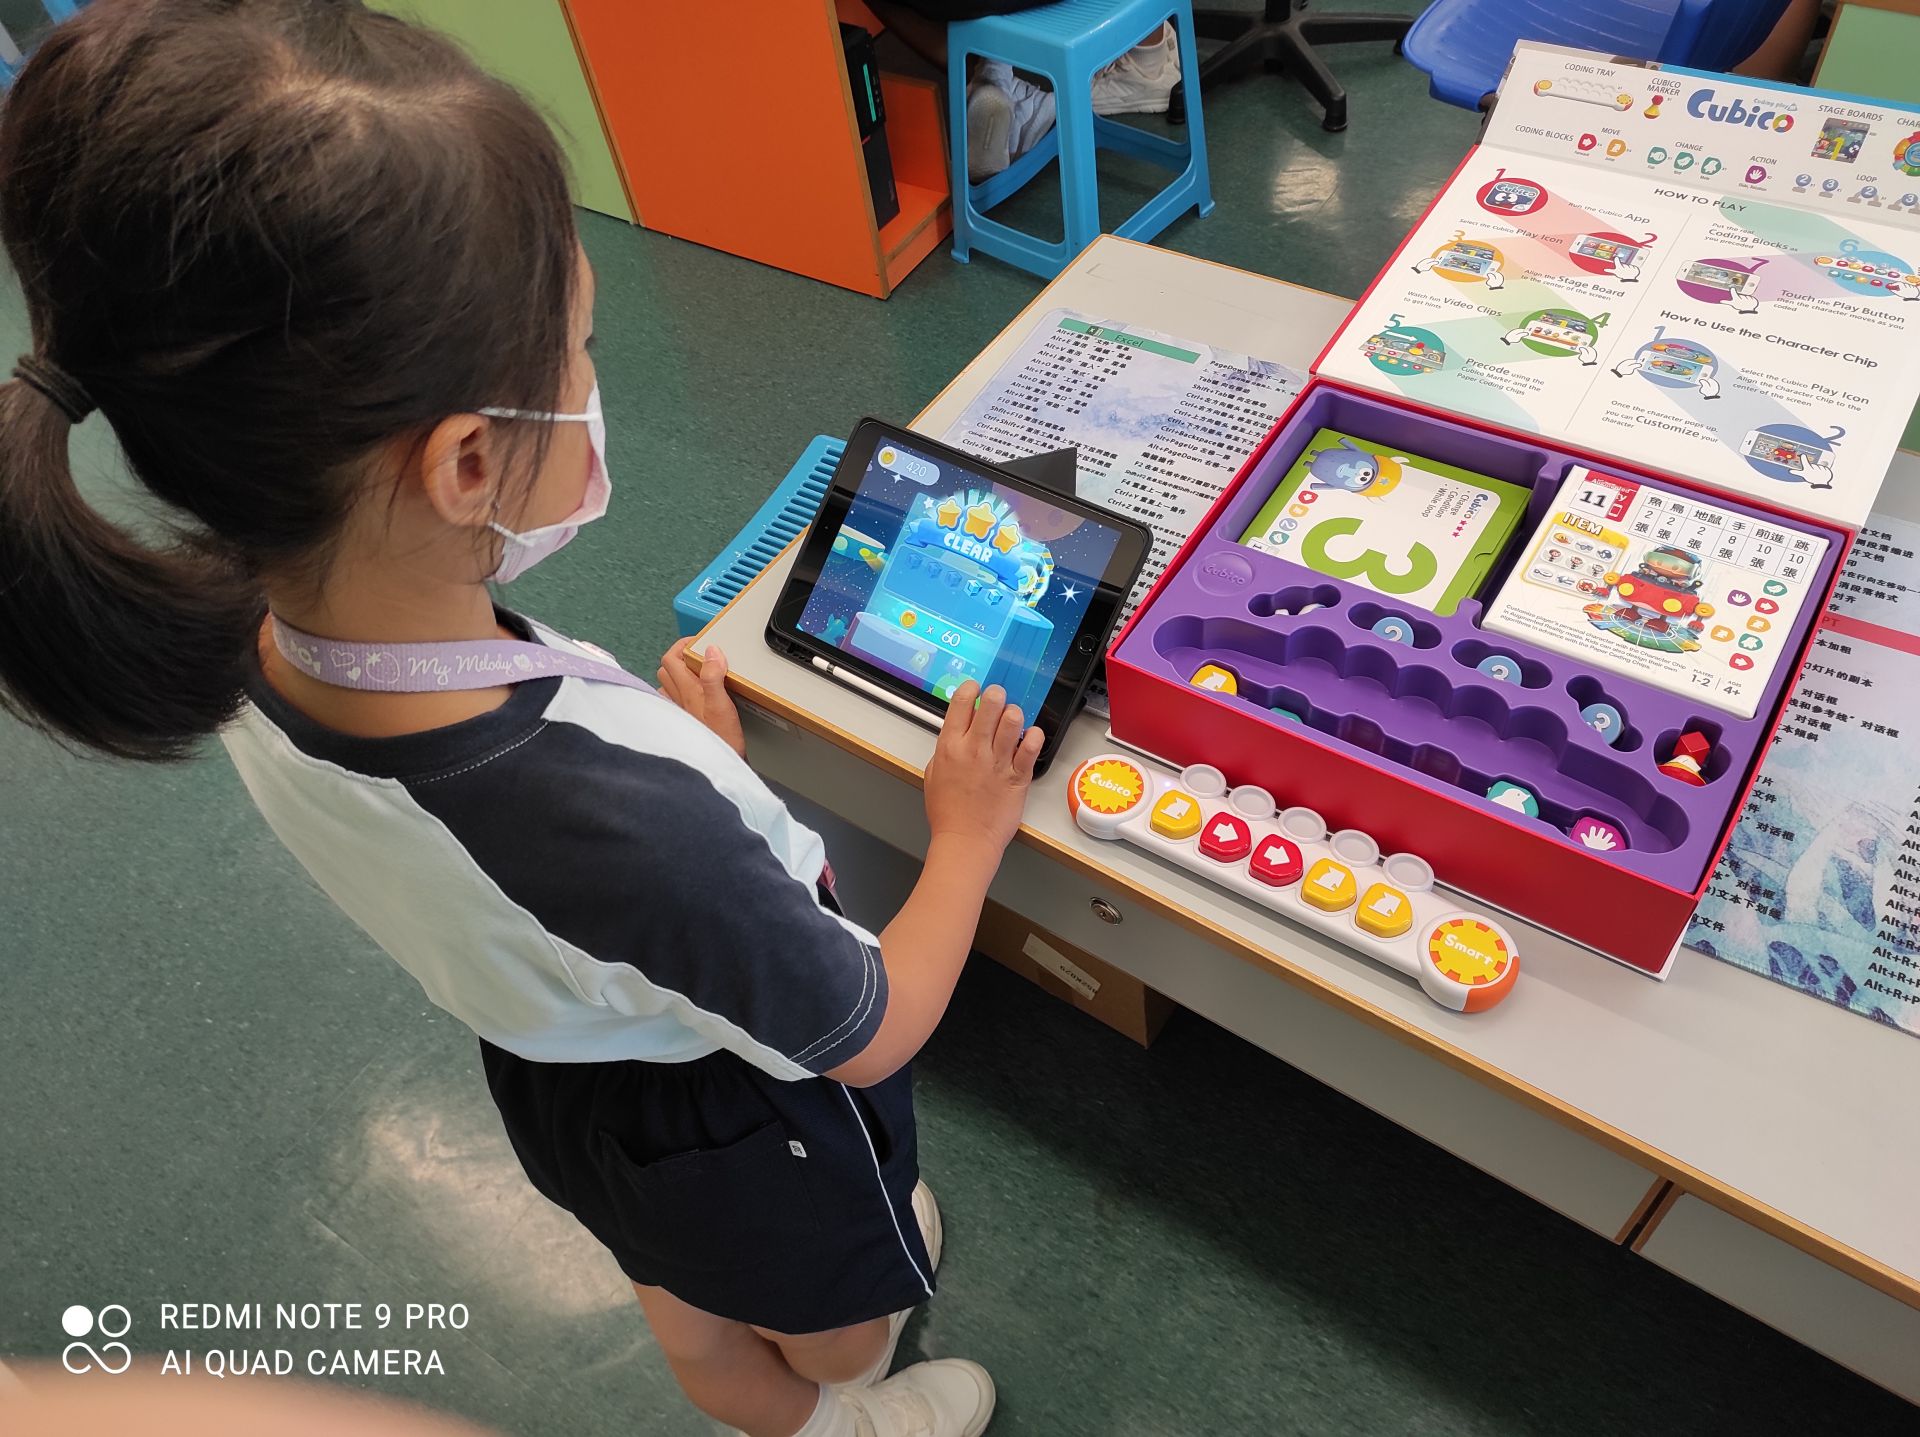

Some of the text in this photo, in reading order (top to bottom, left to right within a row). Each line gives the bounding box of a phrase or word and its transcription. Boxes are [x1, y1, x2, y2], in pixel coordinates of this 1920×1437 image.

[1565, 63, 1616, 77] CODING TRAY
[1647, 85, 1680, 96] MARKER
[1652, 78, 1681, 88] CUBICO
[1687, 89, 1794, 133] Cubico
[1818, 105, 1883, 121] STAGE BOARDS
[1515, 125, 1573, 141] CODING BLOCKS
[1601, 128, 1621, 136] MOVE
[1675, 142, 1703, 151] CHANGE
[1750, 156, 1777, 165] ACTION
[1654, 188, 1746, 211] HOW TO PLAY
[1598, 208, 1623, 217] Cubico
[1624, 213, 1650, 224] App
[1493, 225, 1514, 234] Cubico
[1515, 228, 1539, 240] Play
[1541, 233, 1563, 244] Icon
[1708, 229, 1789, 250] Coding Blocks
[1720, 239, 1754, 250] preceded
[1524, 269, 1544, 279] Align
[1559, 275, 1589, 290] Stage
[1592, 282, 1626, 298] Board
[1543, 280, 1611, 301] center screen
[1407, 290, 1428, 300] Watch
[1443, 296, 1473, 310] Video
[1477, 305, 1502, 318] Clips
[1425, 301, 1442, 310] hints
[1773, 303, 1797, 312] coded
[1776, 297, 1795, 305] then
[1812, 305, 1848, 317] character
[1850, 314, 1875, 324] moves
[1888, 323, 1904, 331] you
[1781, 290, 1905, 324] Touch the Play Button
[1384, 314, 1405, 330] 5
[1115, 335, 1143, 347] Excel
[1660, 310, 1878, 369] How to Use the Character Chip
[1210, 361, 1247, 374] PageDown
[1465, 357, 1545, 385] Precode using the
[1456, 373, 1525, 396] Paper Coding Chips
[1461, 366, 1541, 392] Cubico Marker and the
[1740, 367, 1870, 404] Select the Cubico Play Icon
[1732, 383, 1811, 407] center the screen
[1736, 374, 1861, 411] Align the Character Chip the
[1601, 416, 1634, 428] character
[1611, 400, 1630, 409] Once
[1647, 410, 1683, 422] character
[1684, 420, 1704, 429] pops
[1605, 409, 1619, 417] you
[1636, 415, 1700, 438] Customize
[1701, 434, 1718, 443] your
[1825, 425, 1845, 446] 2
[906, 462, 927, 477] 420
[1422, 488, 1447, 518] While loop
[1436, 491, 1459, 518] Condition
[1450, 495, 1470, 516] Change
[1580, 491, 1607, 508] 11
[1562, 512, 1603, 536] ITEM
[1647, 496, 1663, 508] 魚
[1671, 503, 1685, 515] 鳥
[1693, 508, 1722, 526] 地鼠
[1732, 520, 1746, 531] 手
[1794, 539, 1810, 552] 跳
[943, 532, 993, 563] CLEAR
[1644, 510, 1804, 564] 2 2 2 8 10 10
[1301, 517, 1437, 594] 3
[1635, 522, 1797, 578] 張 張 張 張 張 張
[1202, 563, 1246, 585] Cubico
[942, 631, 960, 647] 60
[408, 654, 512, 686] My Melody
[1691, 673, 1711, 687] 1-2
[1724, 686, 1741, 697] 4+
[1089, 772, 1132, 798] Cubico
[1444, 933, 1495, 968] Smart
